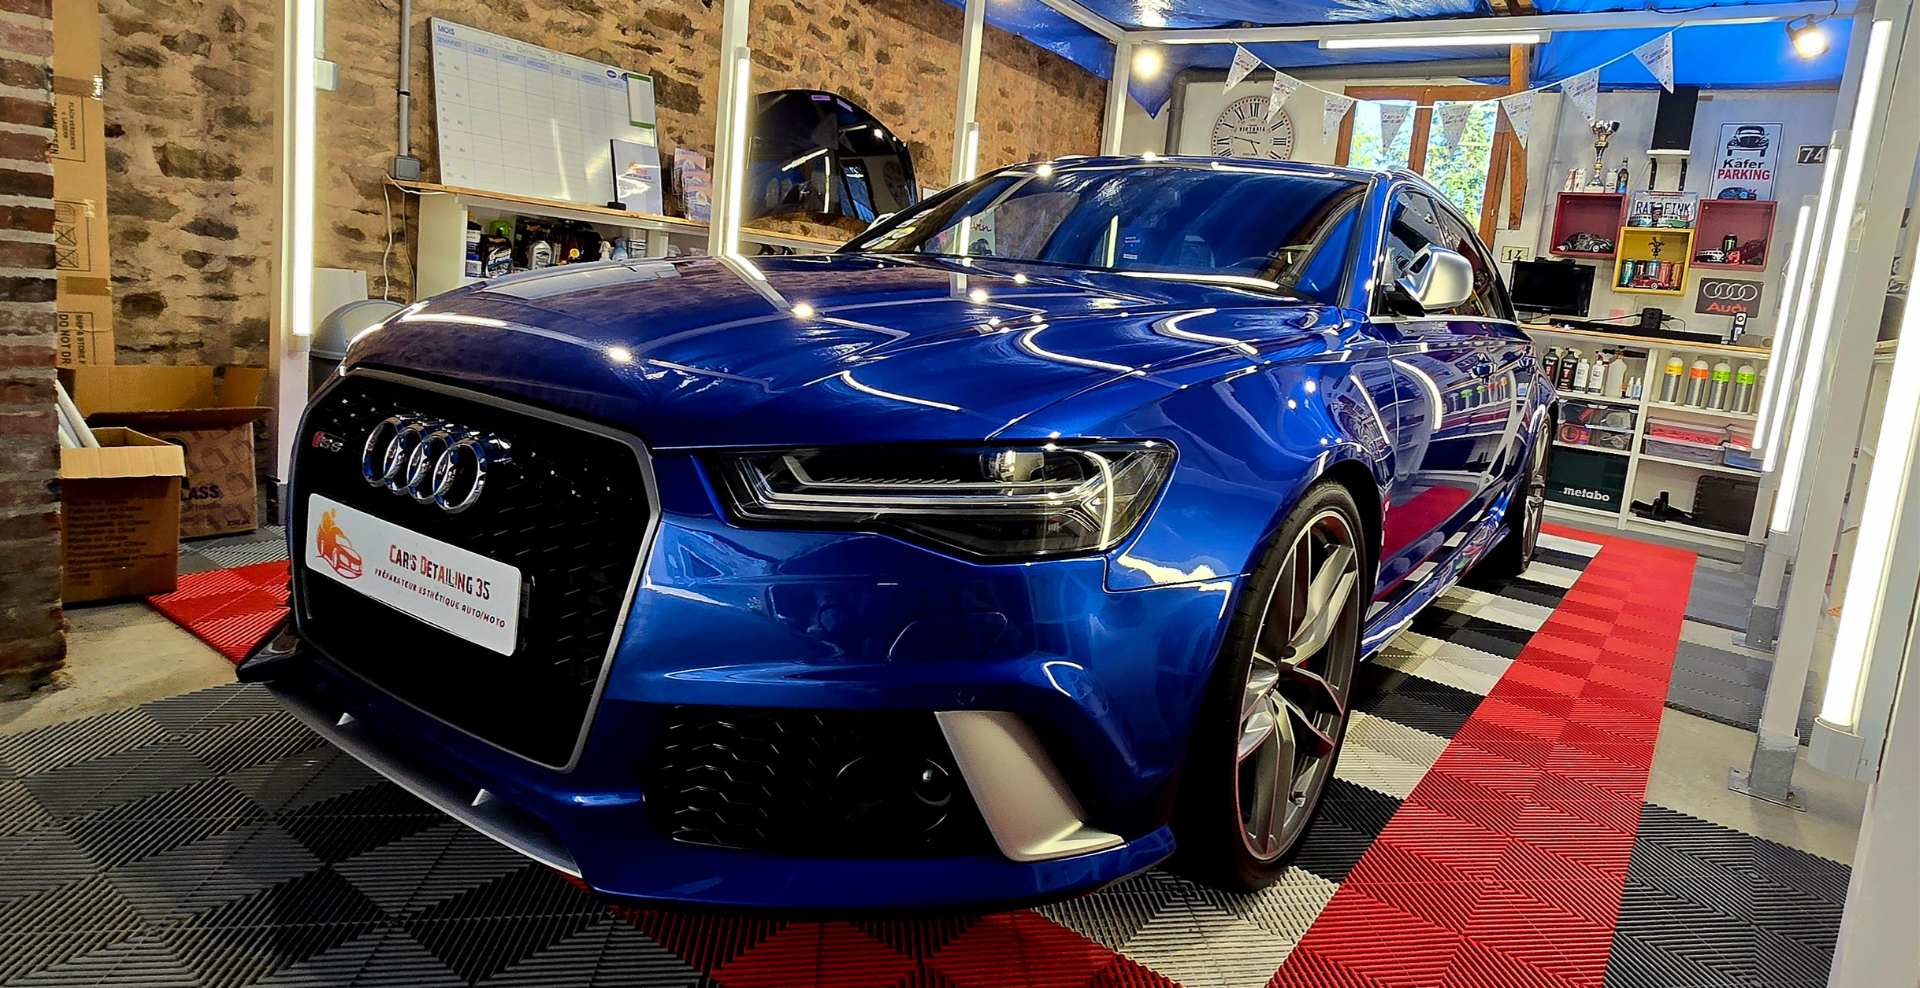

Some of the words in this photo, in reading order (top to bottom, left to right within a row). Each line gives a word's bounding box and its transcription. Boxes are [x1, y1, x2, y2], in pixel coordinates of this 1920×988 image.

[437, 25, 455, 35] MOIS
[437, 36, 462, 47] SEMAINES
[1801, 147, 1826, 163] 74
[1722, 157, 1766, 169] Käfer
[1717, 169, 1771, 181] PARKING
[1636, 201, 1656, 215] RAT
[1664, 202, 1692, 216] FINK
[1507, 249, 1523, 261] 14
[1706, 300, 1748, 313] Audi
[59, 314, 69, 328] DO
[60, 330, 71, 349] NOT
[61, 351, 72, 364] DR
[180, 485, 220, 501] LASS
[1562, 487, 1611, 502] metabo
[389, 544, 418, 572] CAR'S
[420, 555, 473, 595] DETAILING
[476, 577, 491, 600] 35
[374, 568, 418, 591] PRÉPARATEUR
[418, 586, 460, 610] ESTHÉTIQUE
[461, 604, 506, 628] AUTO/MOTO
